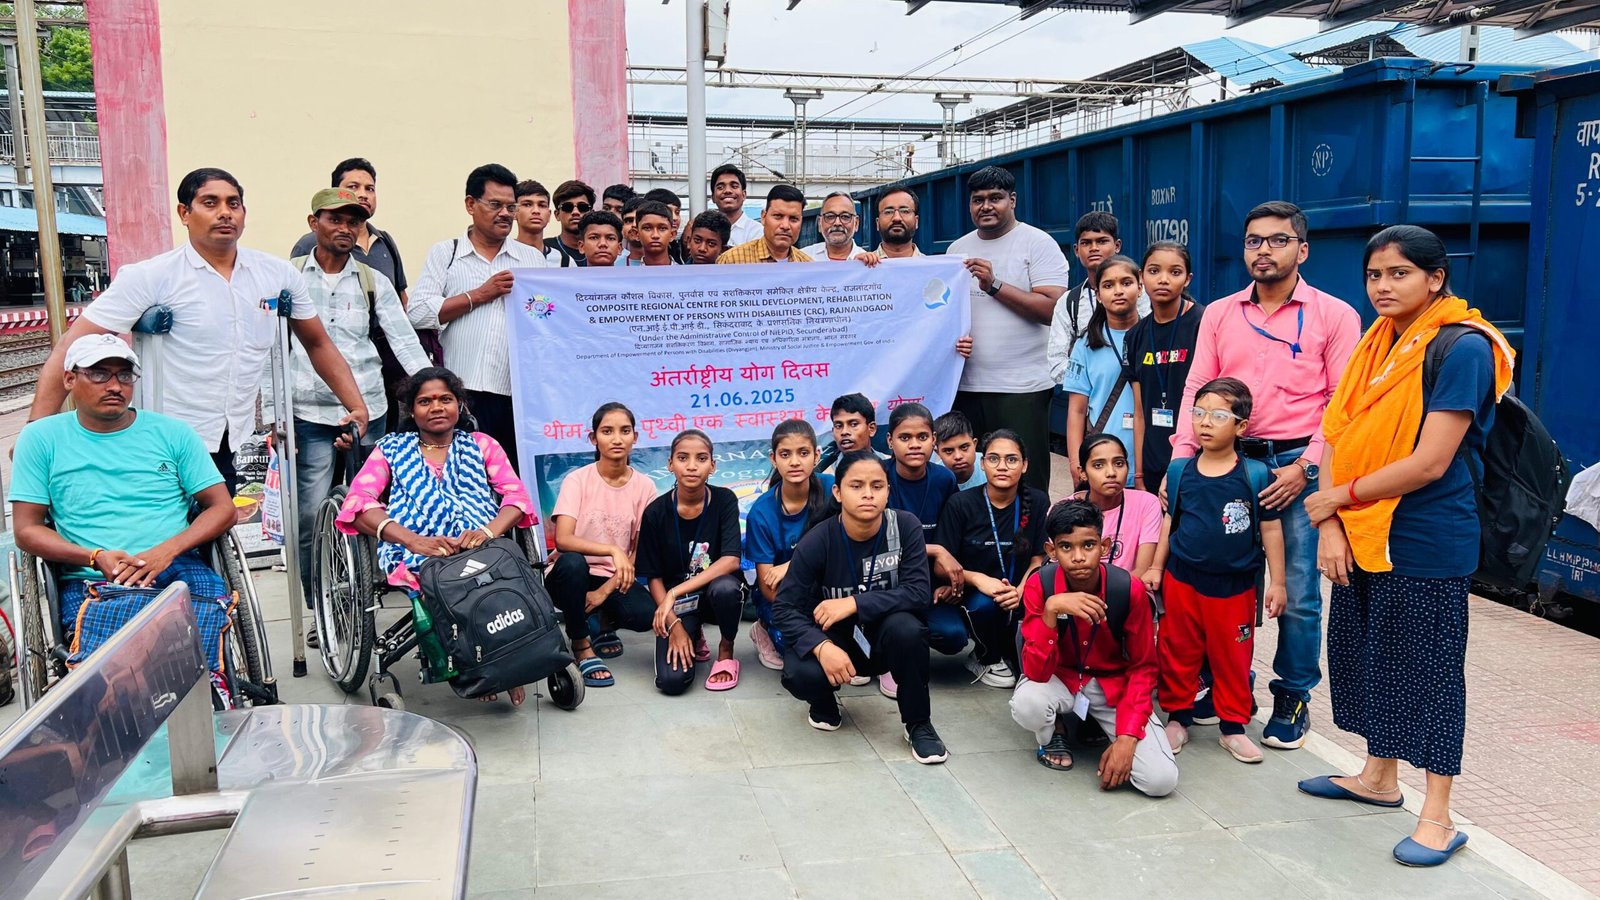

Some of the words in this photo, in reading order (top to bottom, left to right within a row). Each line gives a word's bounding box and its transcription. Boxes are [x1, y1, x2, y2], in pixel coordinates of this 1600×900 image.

[586, 303, 639, 312] COMPOSITE
[640, 302, 684, 311] REGIONAL
[686, 301, 719, 309] CENTRE
[720, 300, 738, 308] FOR
[739, 299, 760, 307] SKILL
[761, 297, 825, 306] DEVELOPMENT,
[826, 293, 892, 303] REHABILITATION
[589, 316, 596, 324] &
[599, 314, 670, 324] EMPOWERMENT
[672, 313, 685, 321] OF
[686, 311, 725, 320] PERSONS
[726, 310, 750, 319] WITH
[751, 308, 802, 318] DISABILITIES
[803, 307, 828, 316] (CRC),
[829, 304, 893, 314] RAJNANDGAON
[638, 334, 665, 343] (Under
[666, 333, 679, 341] the
[679, 331, 732, 340] Administrative
[732, 330, 760, 338] Control
[760, 329, 769, 337] of
[796, 326, 848, 335] Secunderabad)
[650, 364, 733, 388] अंतर्राष्ट्रीय
[739, 362, 774, 381] योग
[781, 360, 830, 380] दिवस
[690, 388, 795, 408] 21.06.2025
[691, 414, 723, 431] एक
[865, 555, 900, 572] BEYON
[487, 609, 525, 634] adidas
